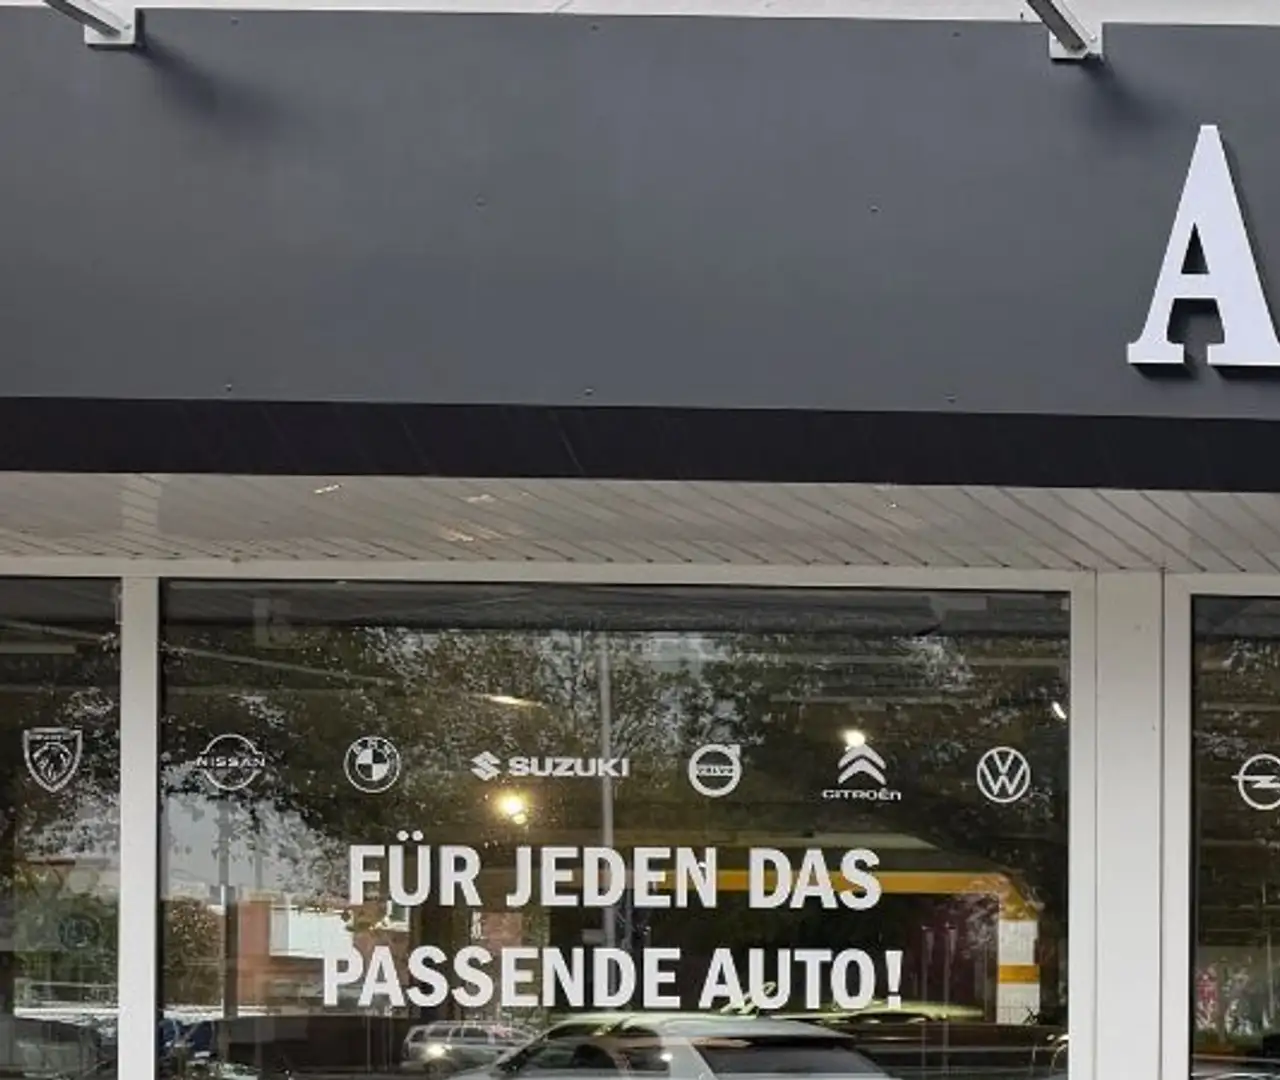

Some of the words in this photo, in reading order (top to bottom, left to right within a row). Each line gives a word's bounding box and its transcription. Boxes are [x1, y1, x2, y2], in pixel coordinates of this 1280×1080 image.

[196, 756, 265, 767] NISSAN
[508, 757, 629, 777] SUZUKI
[348, 830, 482, 907] FÜR
[506, 846, 716, 909] JEDEN
[749, 847, 881, 911] DAS
[323, 946, 680, 1008] PASSENDE
[698, 948, 902, 1010] AUTO!
